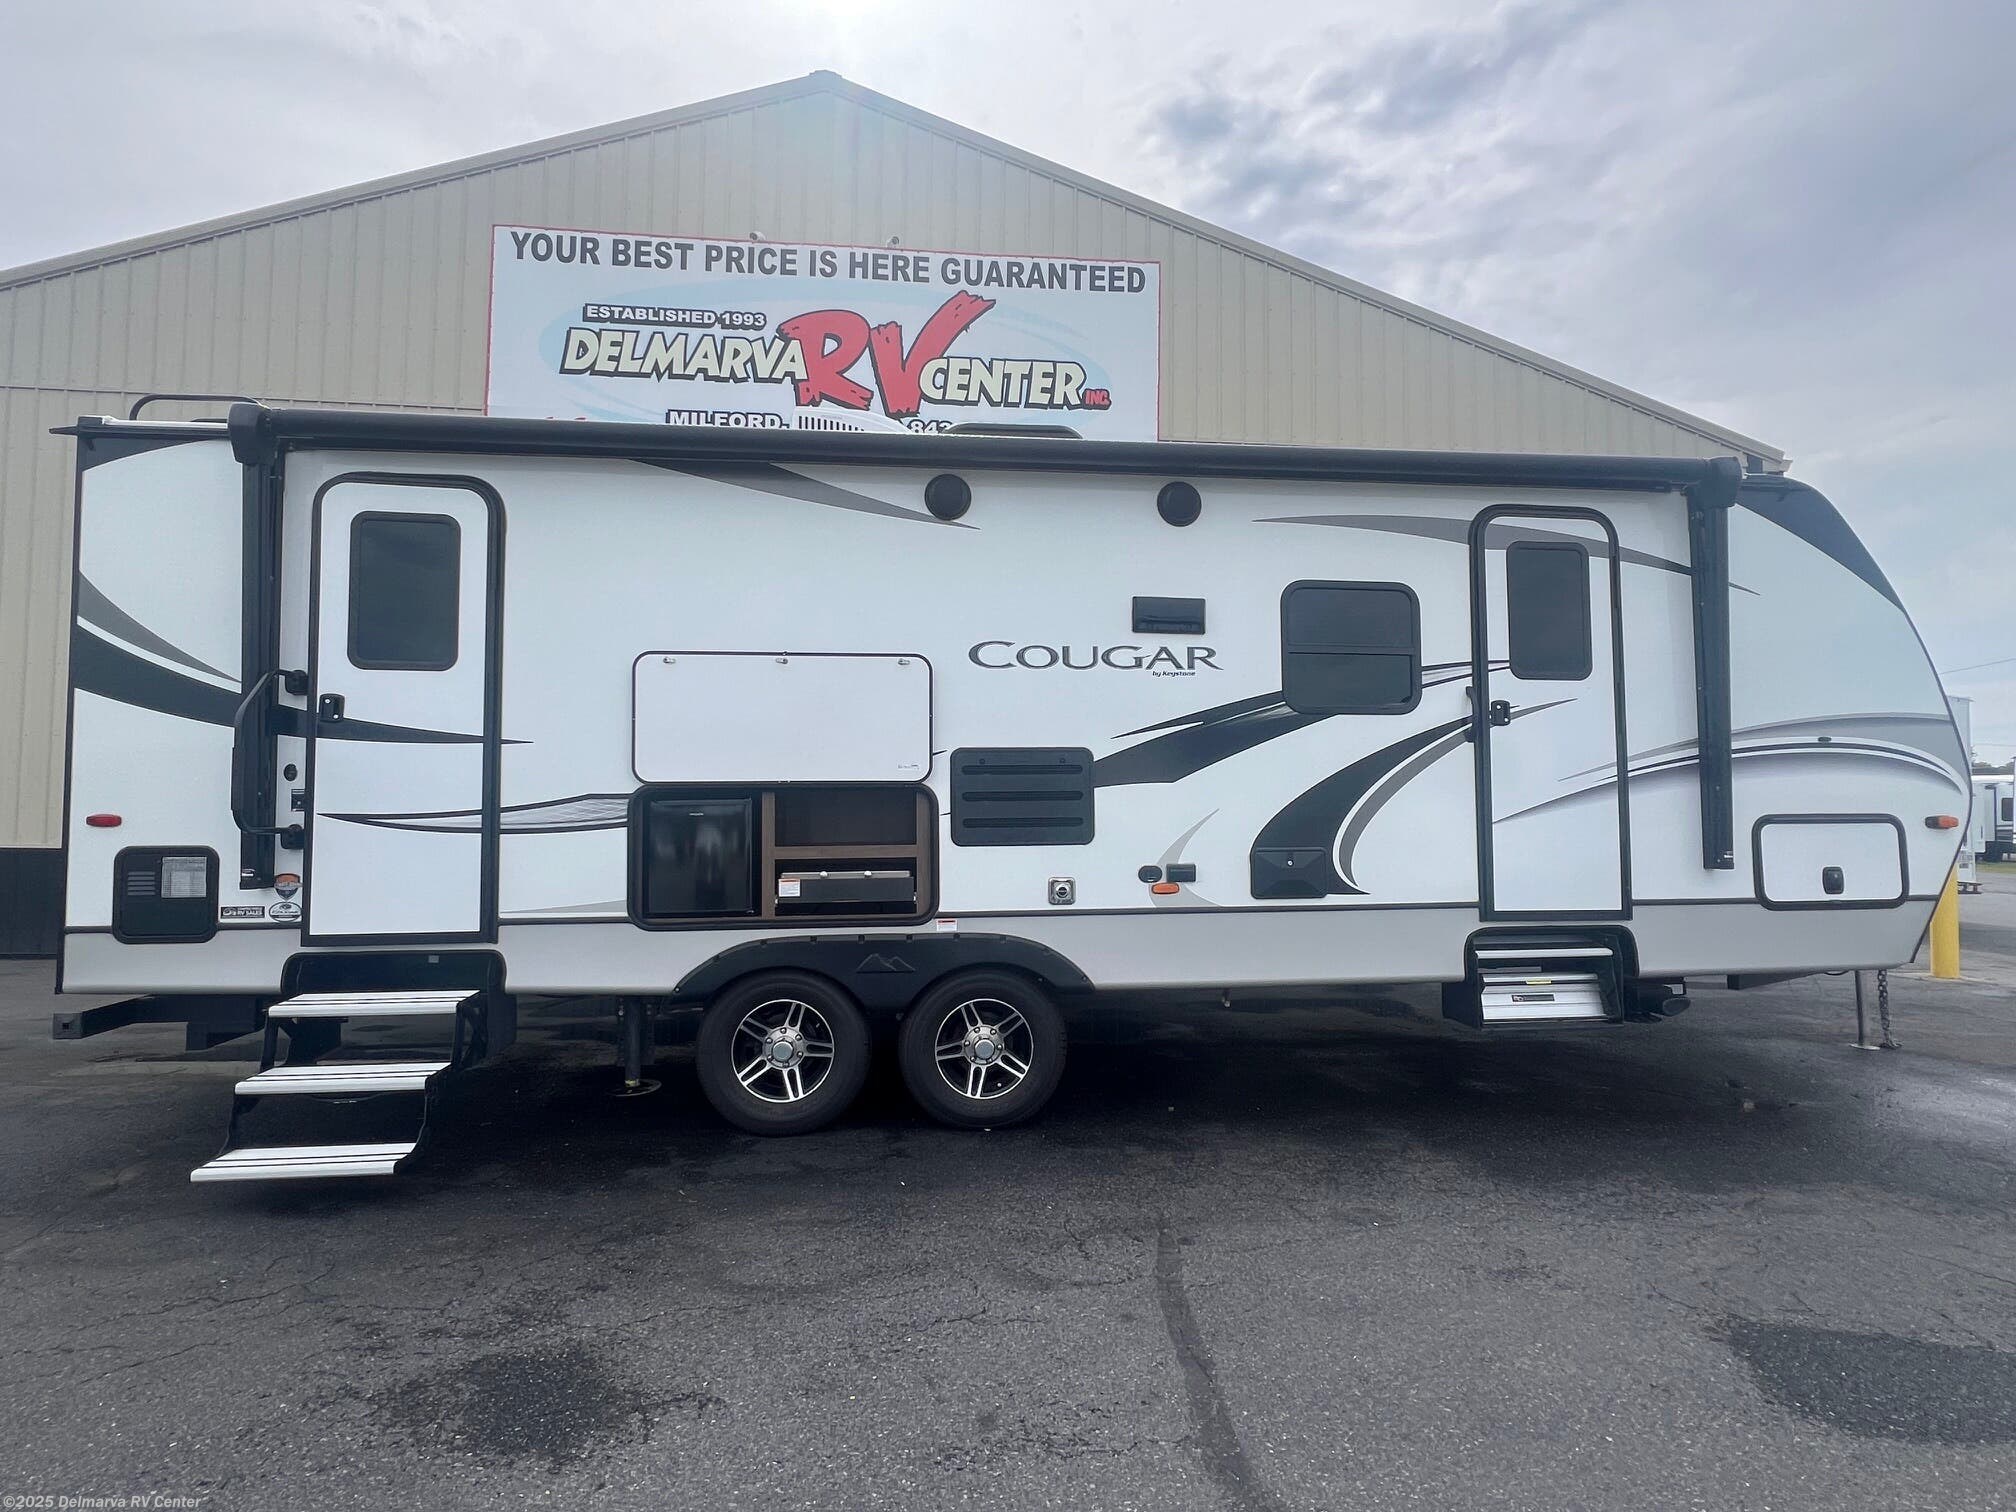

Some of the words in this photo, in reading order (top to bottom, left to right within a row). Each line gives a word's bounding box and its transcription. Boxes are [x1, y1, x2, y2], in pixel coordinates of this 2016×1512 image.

[511, 232, 600, 265] YOUR
[611, 238, 694, 270] BEST
[704, 244, 798, 276] PRICE
[809, 249, 838, 279] IS
[848, 252, 930, 283] HERE
[940, 257, 1146, 293] GUARANTEED
[584, 304, 717, 326] ESTABLISHED
[721, 311, 767, 329] 1993
[560, 327, 809, 383] DELMARVA
[776, 290, 996, 419] RV
[918, 356, 1087, 409] CENTER
[968, 640, 1224, 670] COUGAR
[1152, 670, 1161, 678] by
